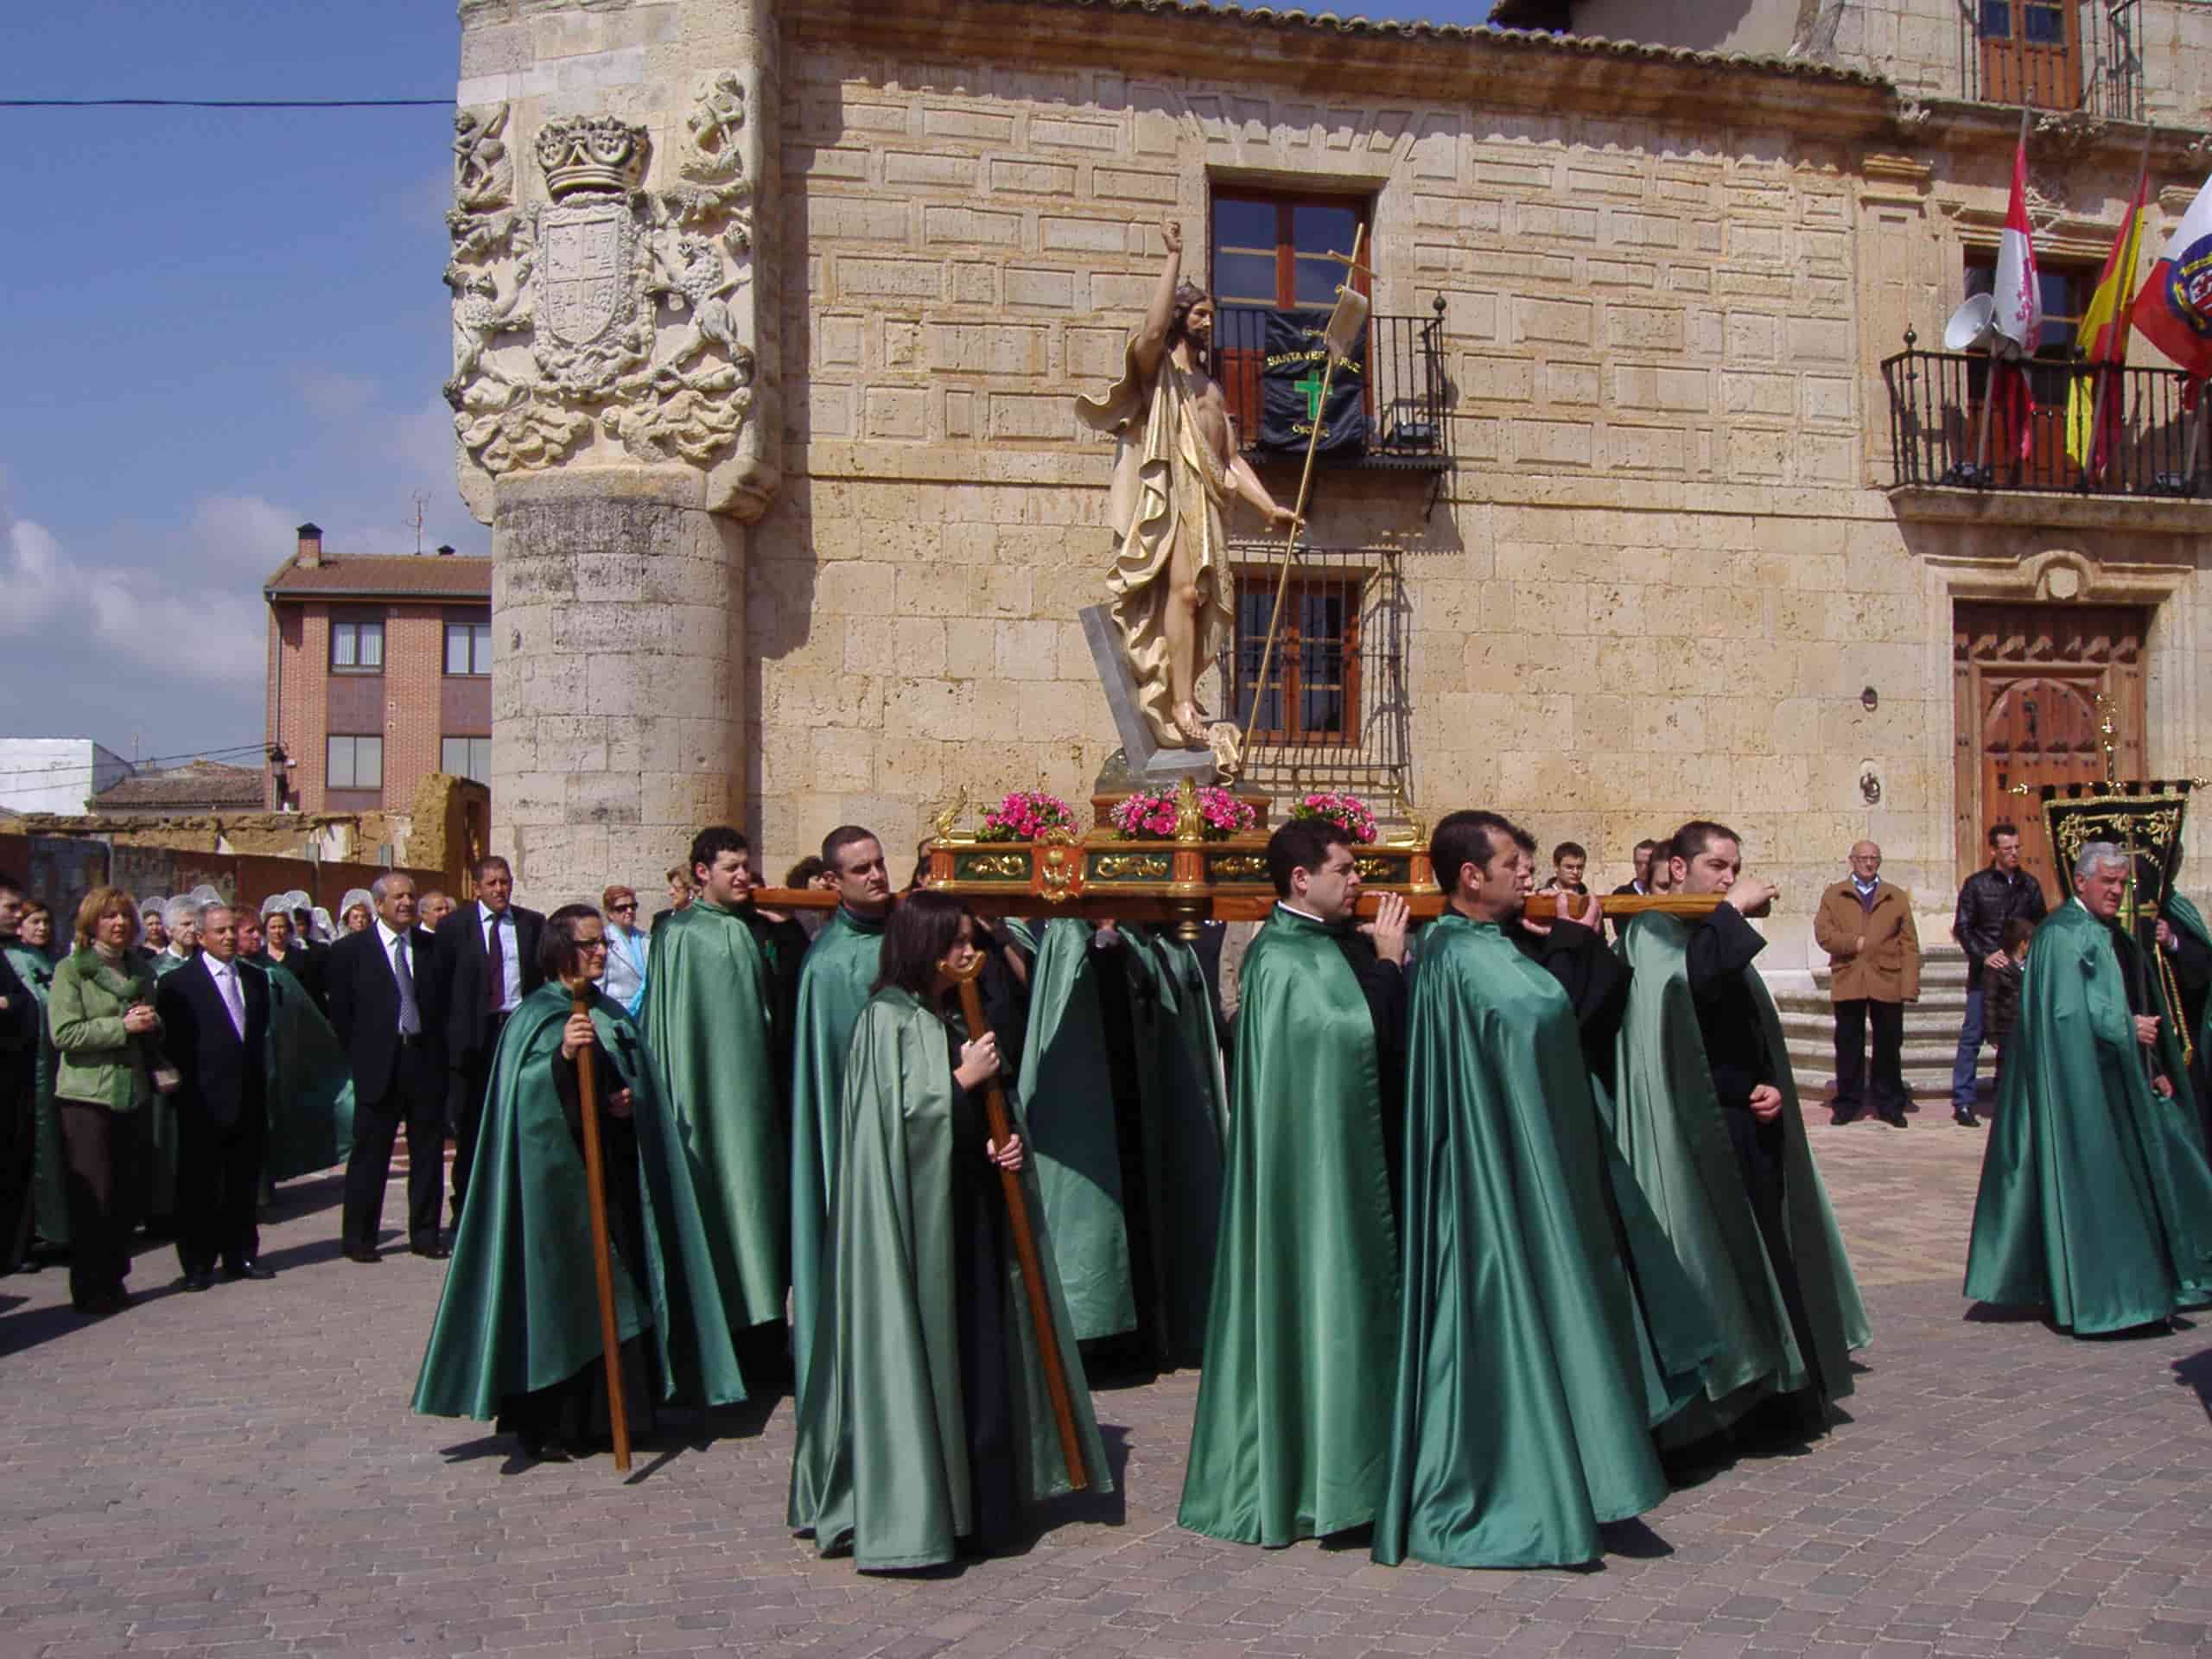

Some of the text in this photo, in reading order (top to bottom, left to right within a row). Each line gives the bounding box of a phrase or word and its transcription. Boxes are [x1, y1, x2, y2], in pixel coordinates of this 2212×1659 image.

[1267, 351, 1363, 374] SANTA VER RUZ
